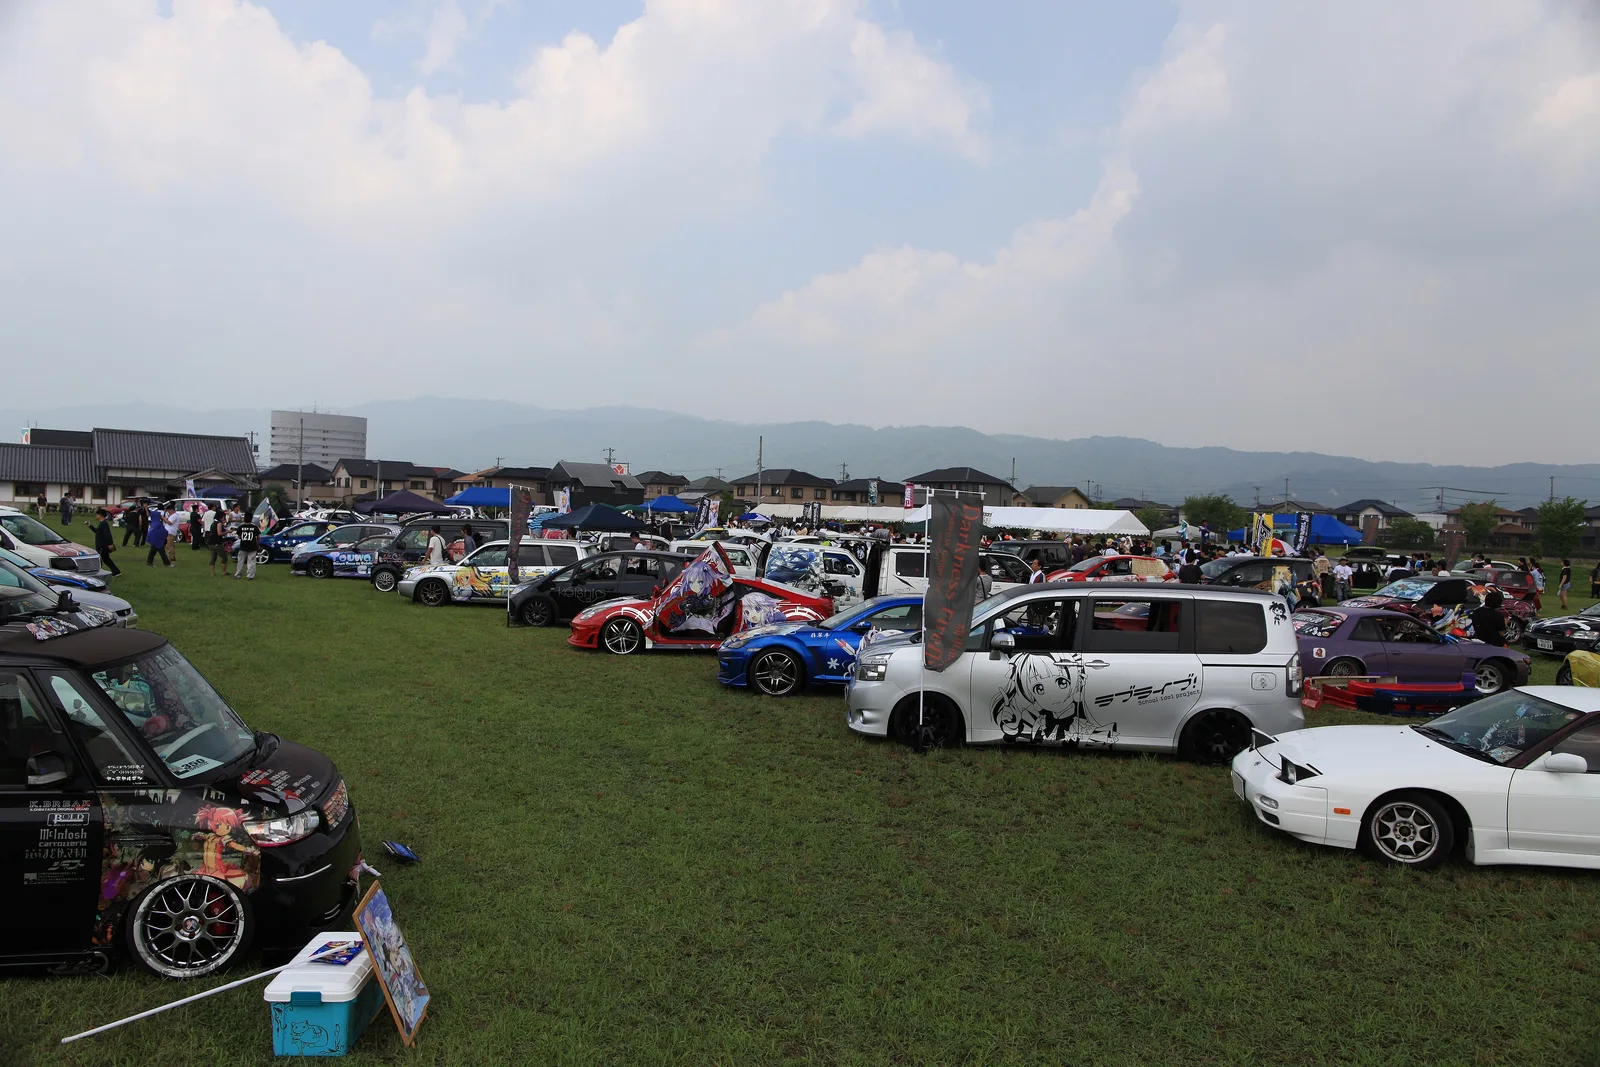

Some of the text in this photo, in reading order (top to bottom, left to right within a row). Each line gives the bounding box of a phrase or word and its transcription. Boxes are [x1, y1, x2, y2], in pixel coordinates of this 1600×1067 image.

[946, 504, 981, 600] Darkness
[1094, 673, 1197, 707] ラブライブ!
[1138, 689, 1200, 706] School idol project
[181, 758, 206, 770] 350
[40, 828, 87, 840] McIntosh
